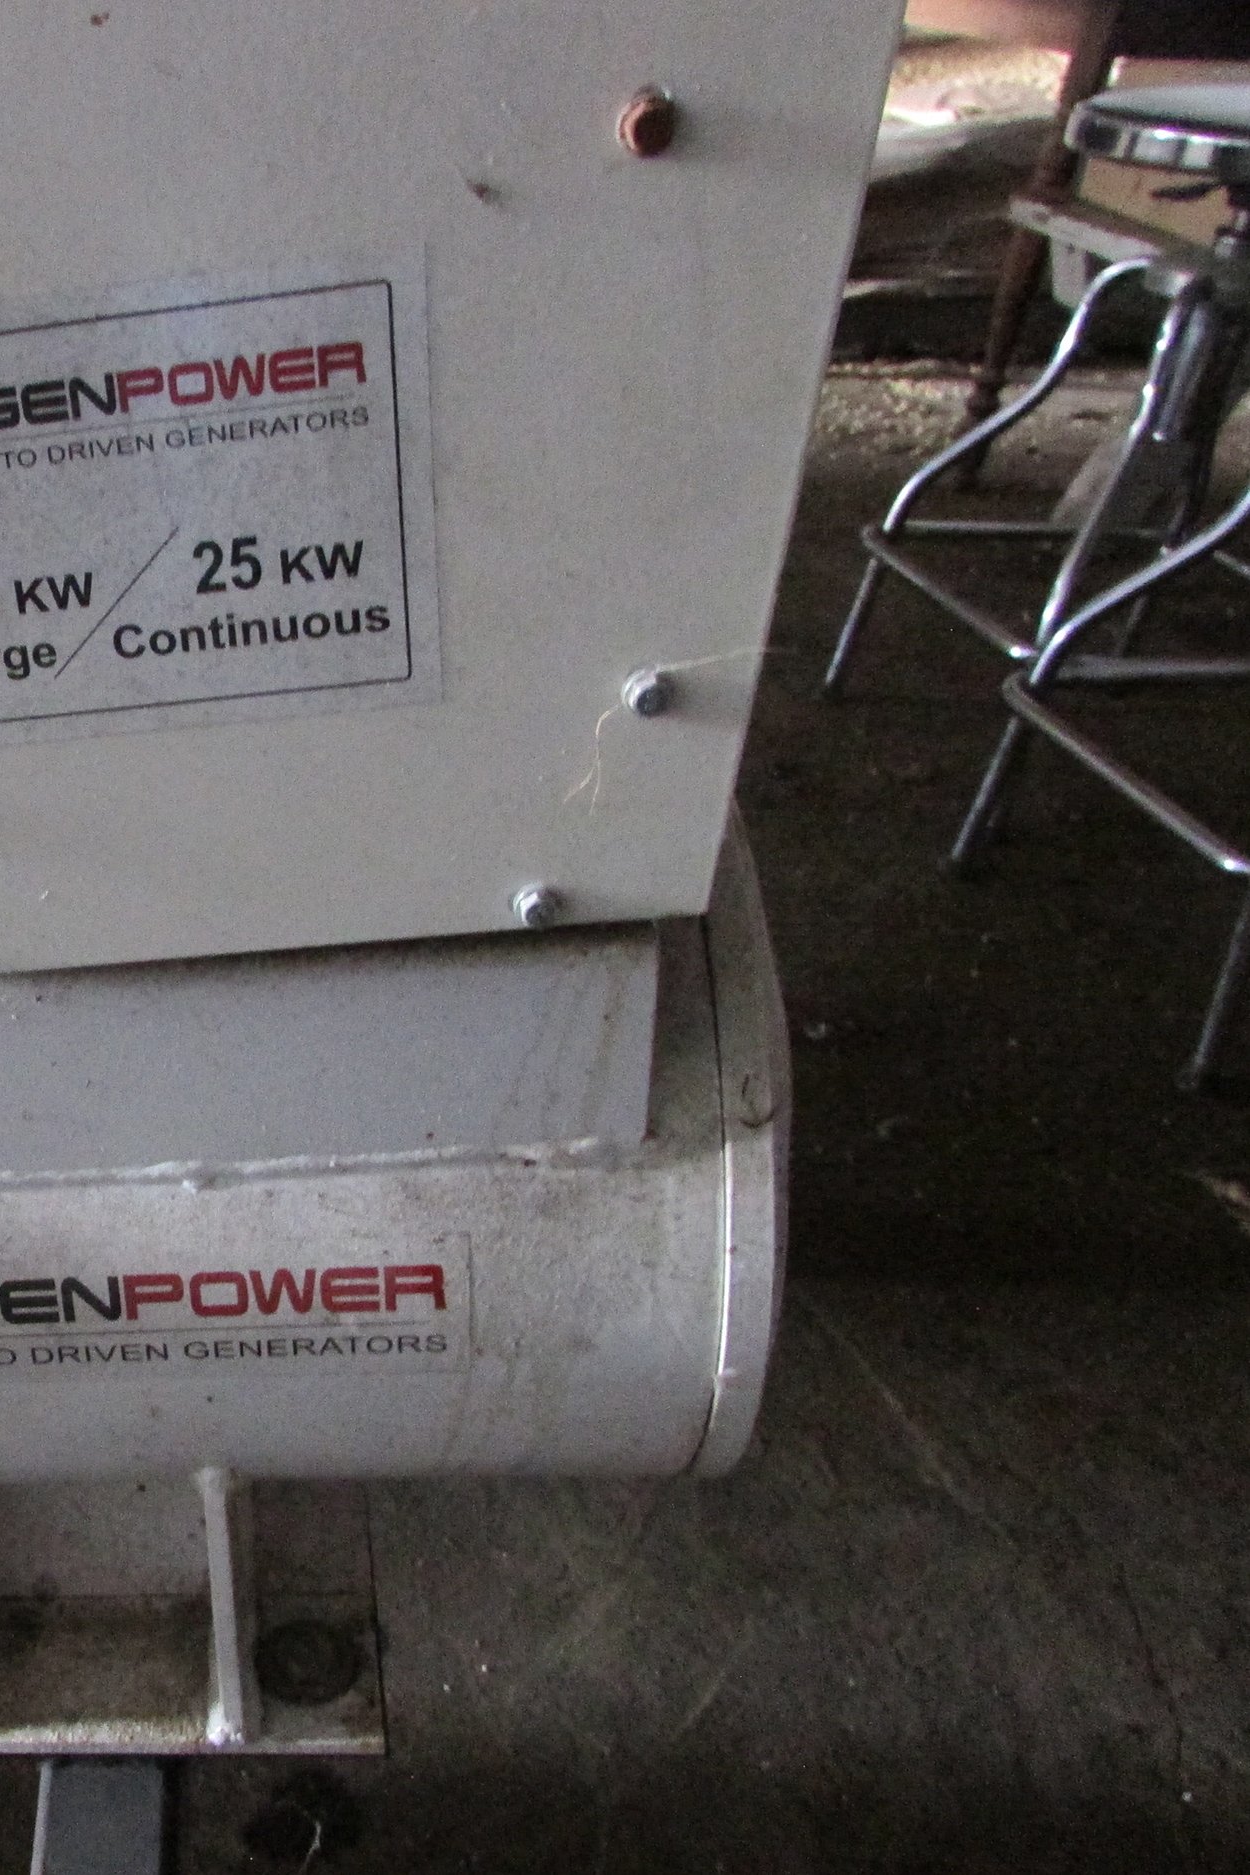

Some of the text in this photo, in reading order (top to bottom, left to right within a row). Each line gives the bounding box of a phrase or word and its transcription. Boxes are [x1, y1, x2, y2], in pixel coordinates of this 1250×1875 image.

[48, 432, 156, 466] DRIVEN
[164, 405, 370, 450] GENERATORS
[193, 536, 262, 595] 25
[112, 604, 391, 659] Continuous
[31, 1341, 170, 1364] DRIVEN
[183, 1333, 449, 1361] GENERATORS
